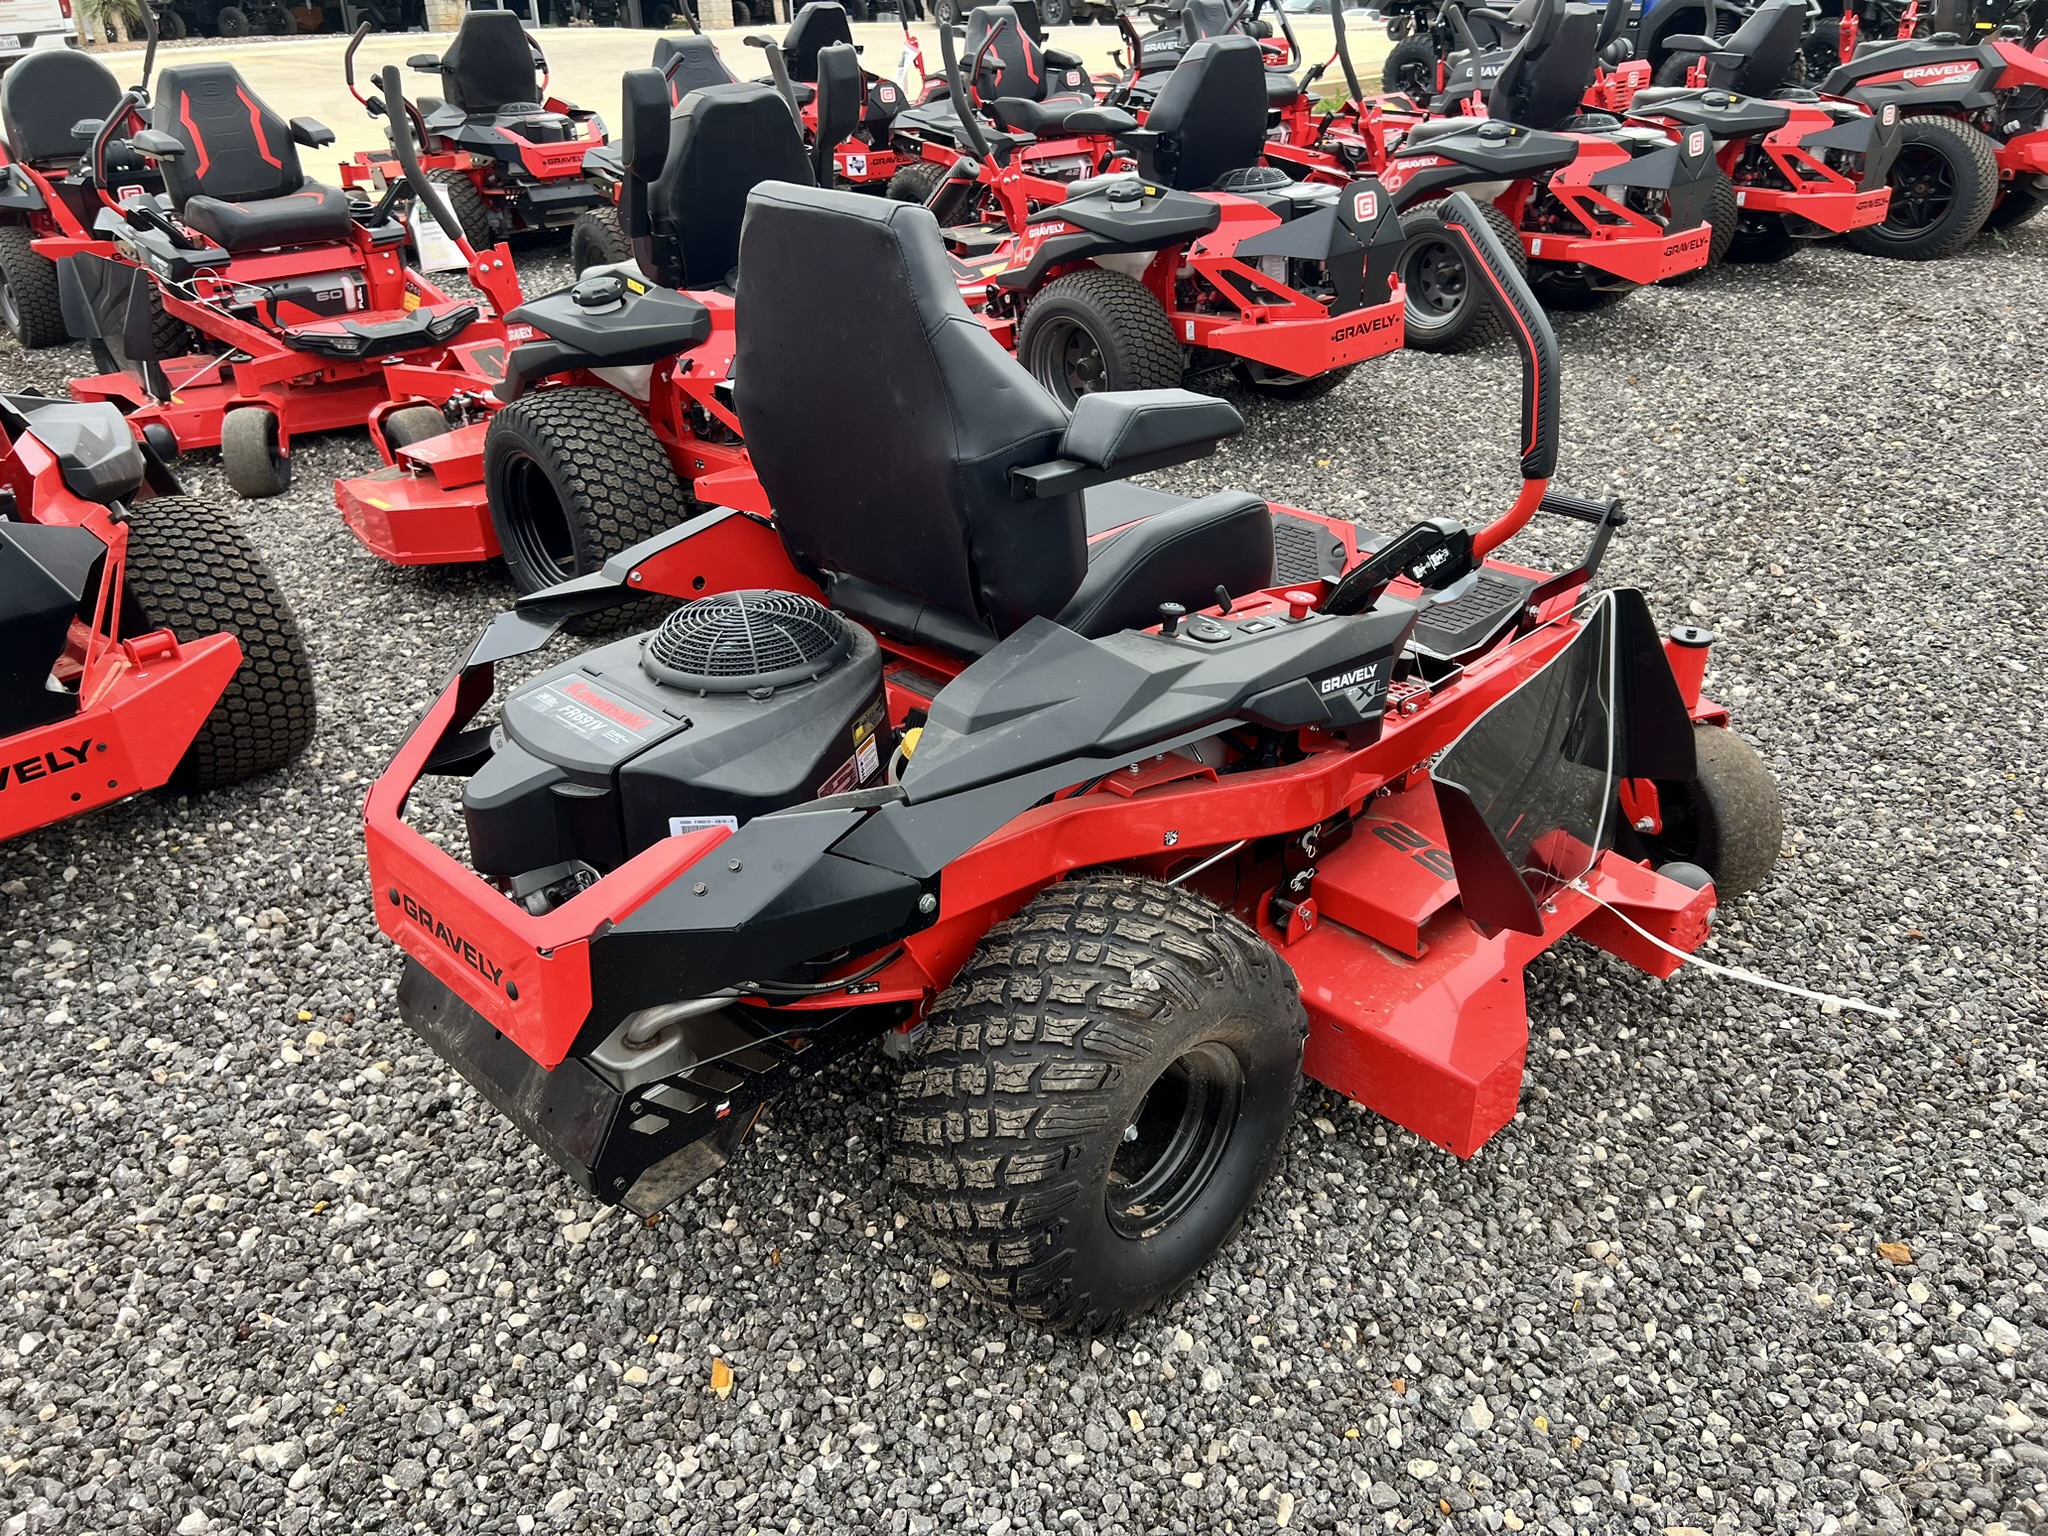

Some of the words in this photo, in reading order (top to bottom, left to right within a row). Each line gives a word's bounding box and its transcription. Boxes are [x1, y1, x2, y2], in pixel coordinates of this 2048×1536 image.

[1903, 63, 1971, 79] GRAVELY
[547, 155, 584, 165] GRAVEL
[1397, 157, 1439, 170] GRAVELY
[1355, 193, 1377, 221] G
[1028, 222, 1065, 239] GRAVELY
[1665, 237, 1706, 257] GRAVELY
[316, 289, 343, 302] 60
[357, 286, 365, 309] FUEL
[1334, 315, 1397, 343] GRAVELY
[1321, 663, 1378, 693] GRAVELY
[1356, 679, 1388, 701] XL
[562, 681, 652, 731] Kawasaki
[557, 704, 608, 731] FR691V
[403, 893, 504, 987] GRAVELY
